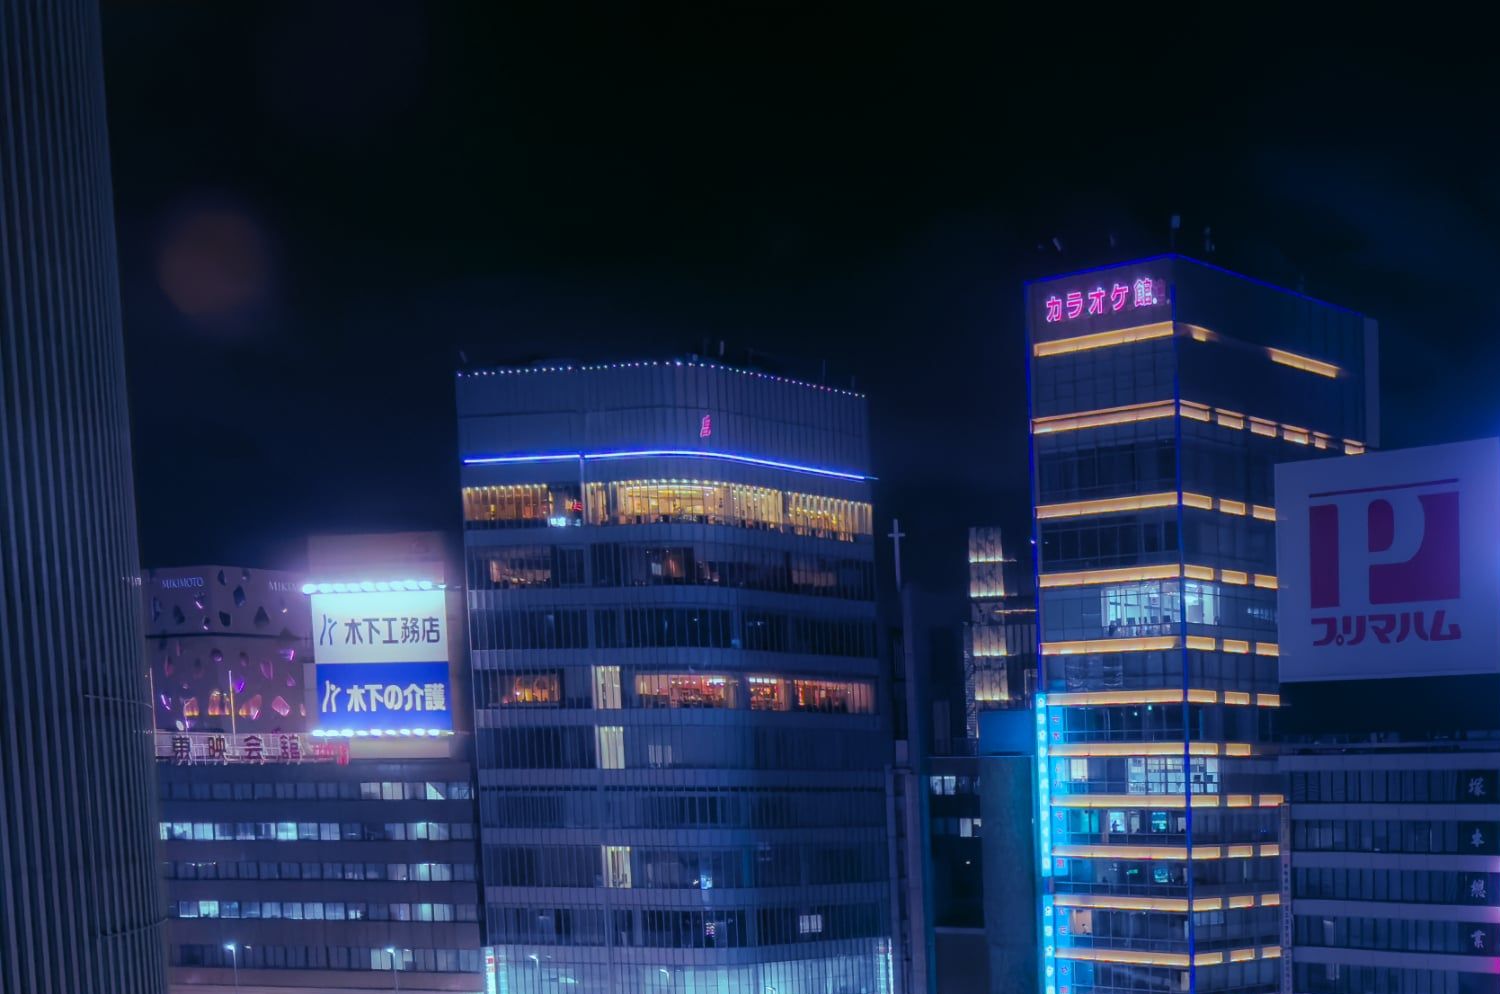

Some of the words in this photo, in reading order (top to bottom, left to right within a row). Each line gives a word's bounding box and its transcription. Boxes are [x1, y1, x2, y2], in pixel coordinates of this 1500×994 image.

[1046, 277, 1153, 322] カラオケ館
[161, 576, 205, 590] MIKIMOTO
[344, 616, 440, 645] 木下工務店
[1311, 610, 1462, 647] プリマハム
[346, 682, 447, 711] 木下の介護
